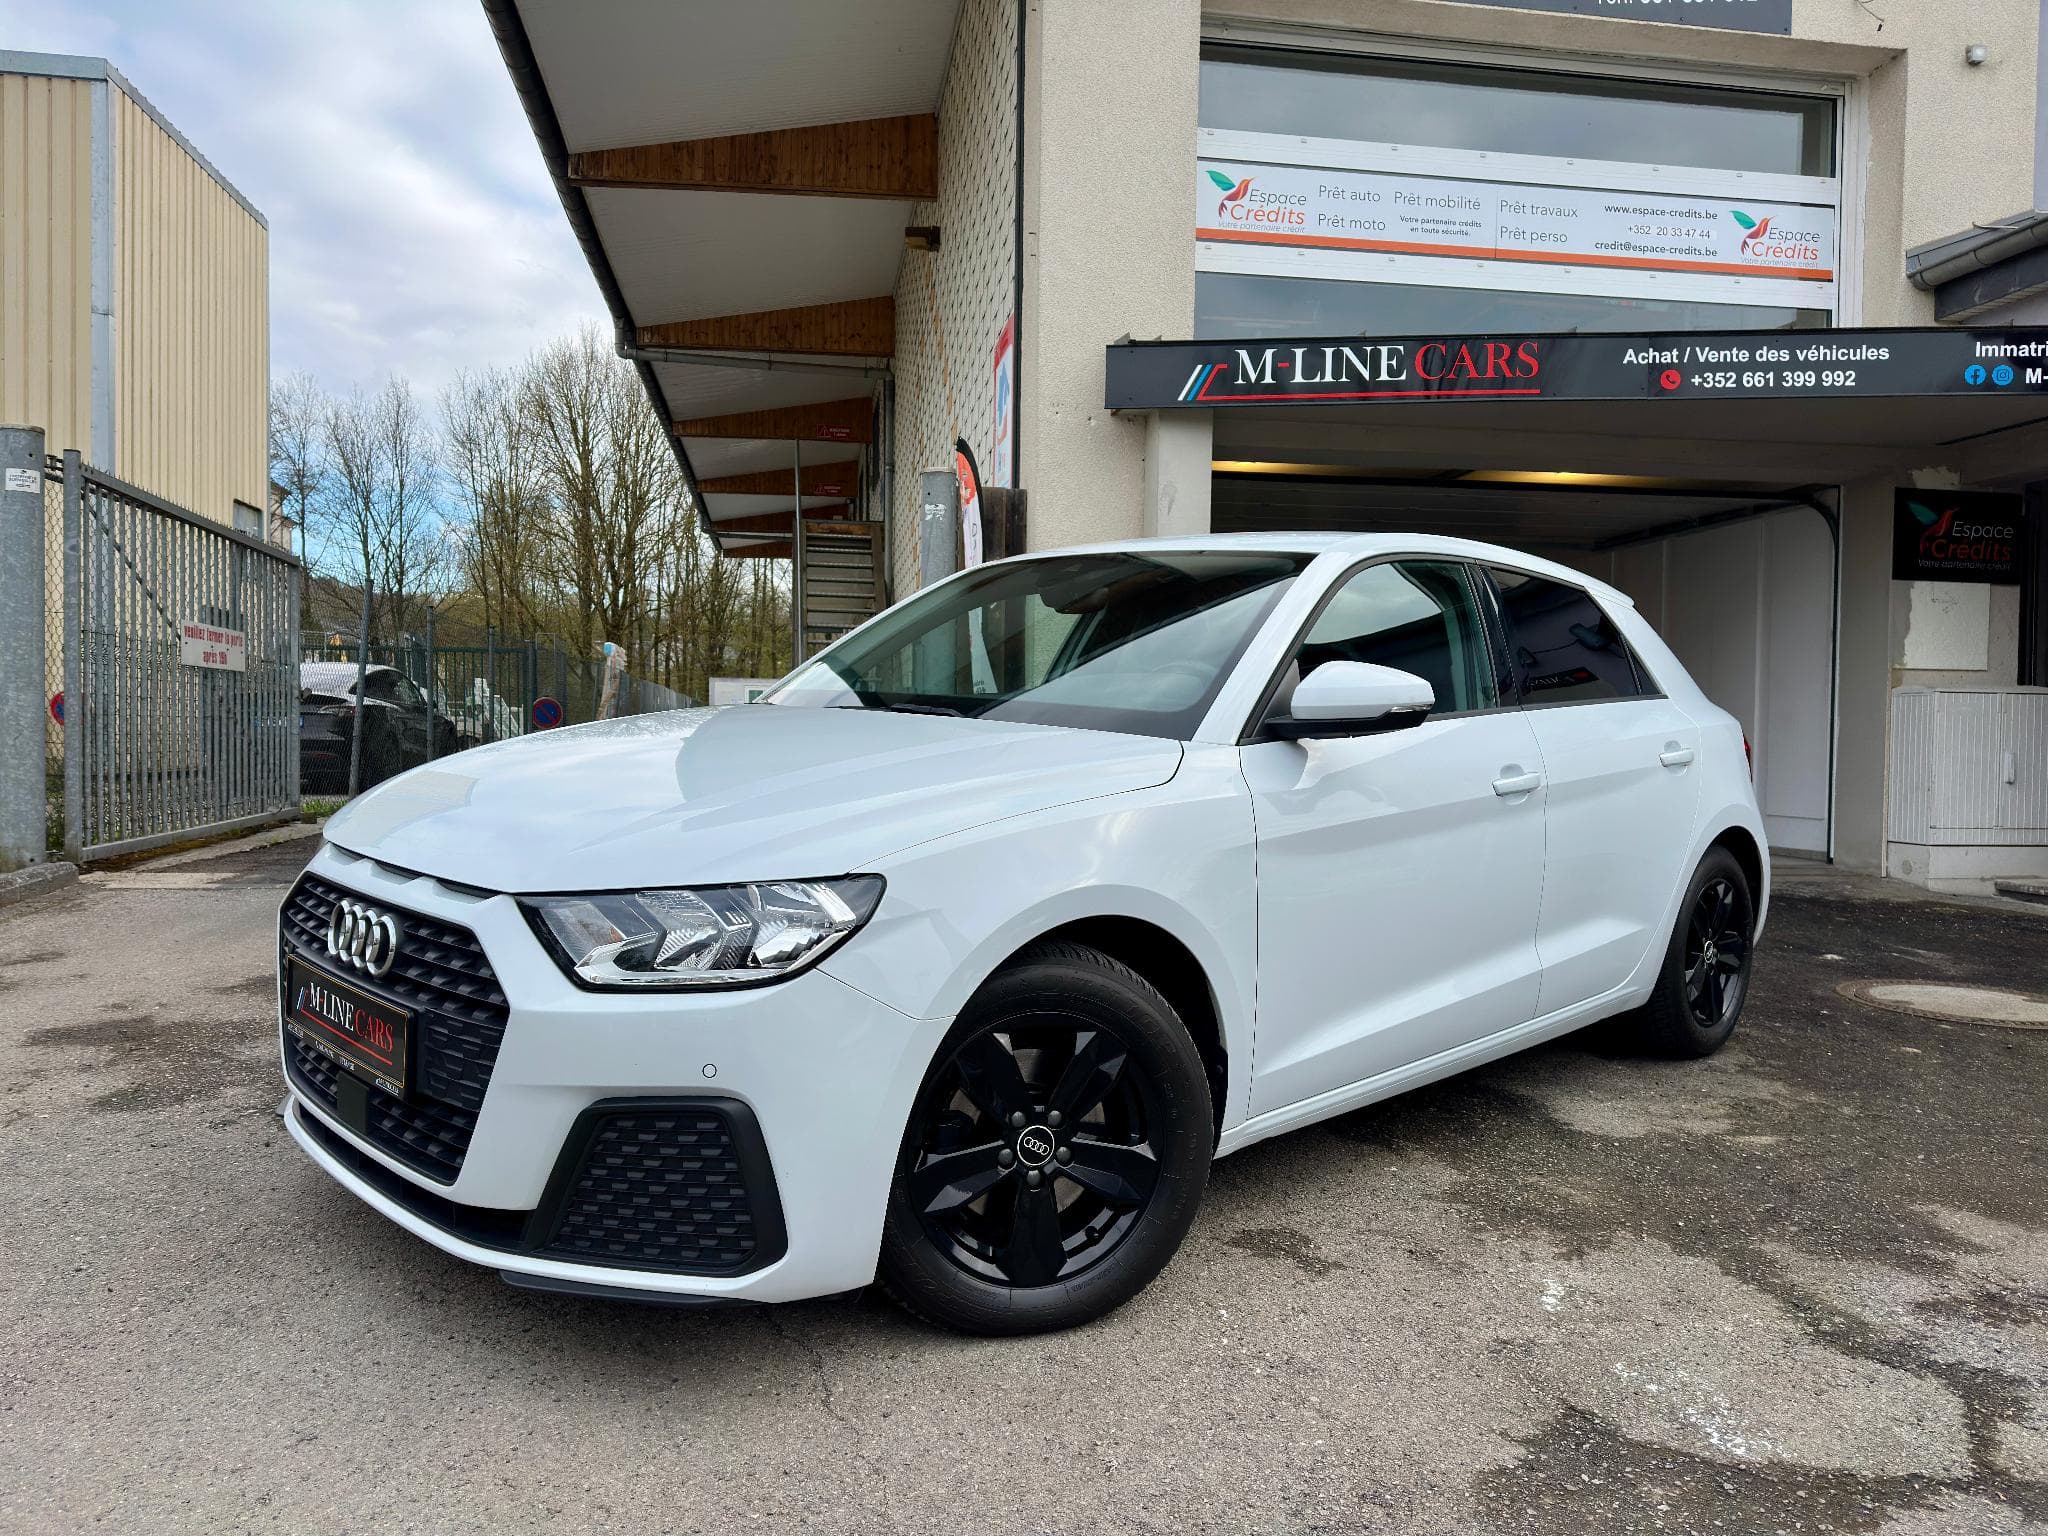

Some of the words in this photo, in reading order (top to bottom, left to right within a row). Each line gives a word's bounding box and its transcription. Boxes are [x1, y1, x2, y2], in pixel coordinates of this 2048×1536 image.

[1249, 189, 1307, 207] Espace
[1319, 185, 1346, 200] Prêt
[1350, 190, 1381, 202] auto
[1394, 191, 1421, 206] Prêt
[1425, 195, 1481, 211] mobilité
[1230, 203, 1305, 225] Crédits
[1500, 200, 1527, 214] Prêt
[1530, 203, 1579, 218] travaux
[1604, 204, 1718, 220] www.espace-credits.be
[1318, 213, 1345, 228] Prêt
[1349, 218, 1386, 232] moto
[1400, 215, 1419, 224] Votre
[1420, 217, 1457, 228] partenaire
[1458, 219, 1482, 229] crédits
[1420, 226, 1440, 234] toute
[1500, 225, 1527, 240] Prêt
[1530, 230, 1568, 244] perso
[1627, 224, 1651, 236] +352
[1656, 226, 1668, 237] 20
[1670, 227, 1682, 238] 33
[1684, 228, 1696, 239] 47
[1698, 229, 1711, 239] 44
[1768, 227, 1821, 243] Espace
[1594, 240, 1718, 257] credit@espace-credits.be
[1752, 241, 1818, 260] Crédits
[1233, 345, 1407, 384] M-LINE
[1414, 342, 1539, 380] CARS
[1623, 348, 1679, 365] Achat
[1683, 347, 1691, 363] /
[1695, 347, 1750, 363] Vente
[1755, 346, 1790, 362] des
[1796, 345, 1890, 361] véhicules
[1690, 372, 1737, 388] +352
[1742, 371, 1774, 387] 661
[1782, 371, 1816, 387] 399
[1822, 370, 1856, 386] 992
[1952, 521, 2014, 540] Espace
[1931, 539, 2011, 560] Crédits
[309, 982, 354, 1032] M-LINE
[354, 1008, 393, 1055] CARS
